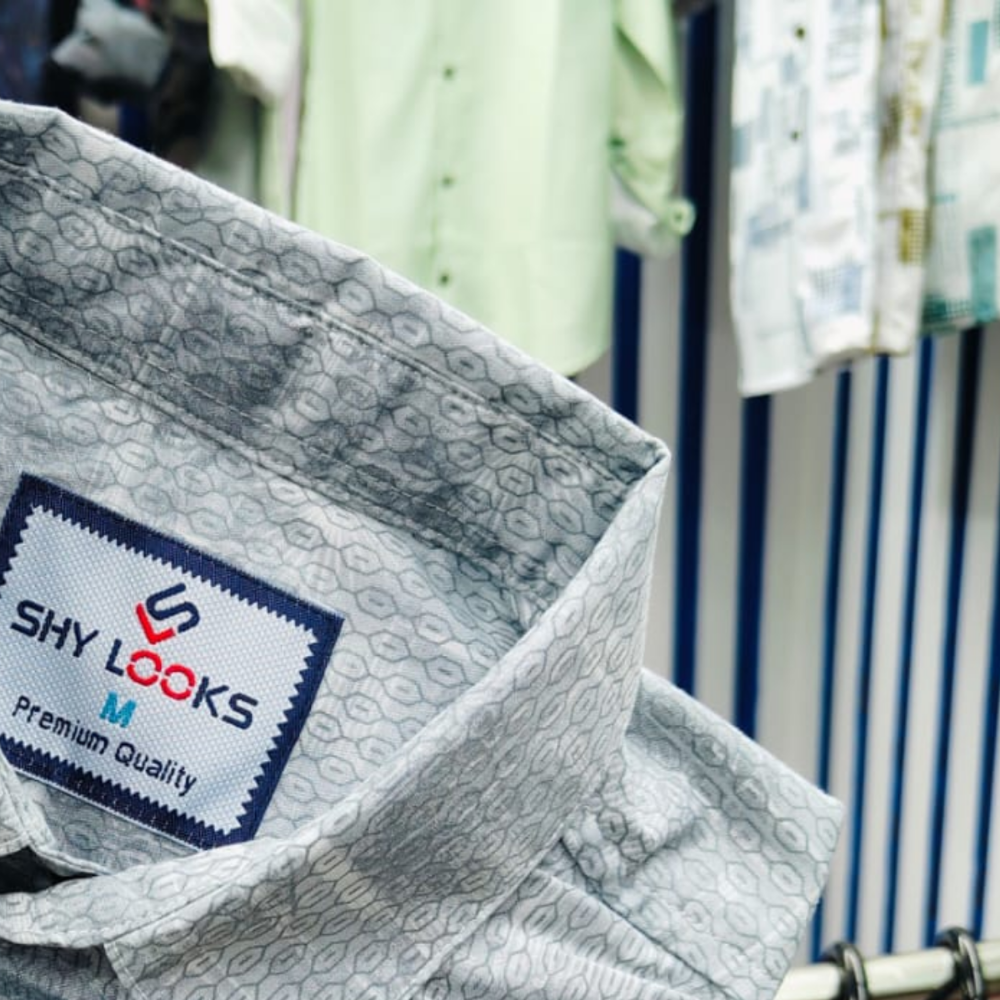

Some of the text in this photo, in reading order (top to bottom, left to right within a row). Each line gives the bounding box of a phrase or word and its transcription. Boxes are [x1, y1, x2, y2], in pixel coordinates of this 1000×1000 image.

[10, 600, 259, 730] SHY LOOKS
[100, 691, 137, 728] M
[11, 695, 197, 797] Premium Quality
